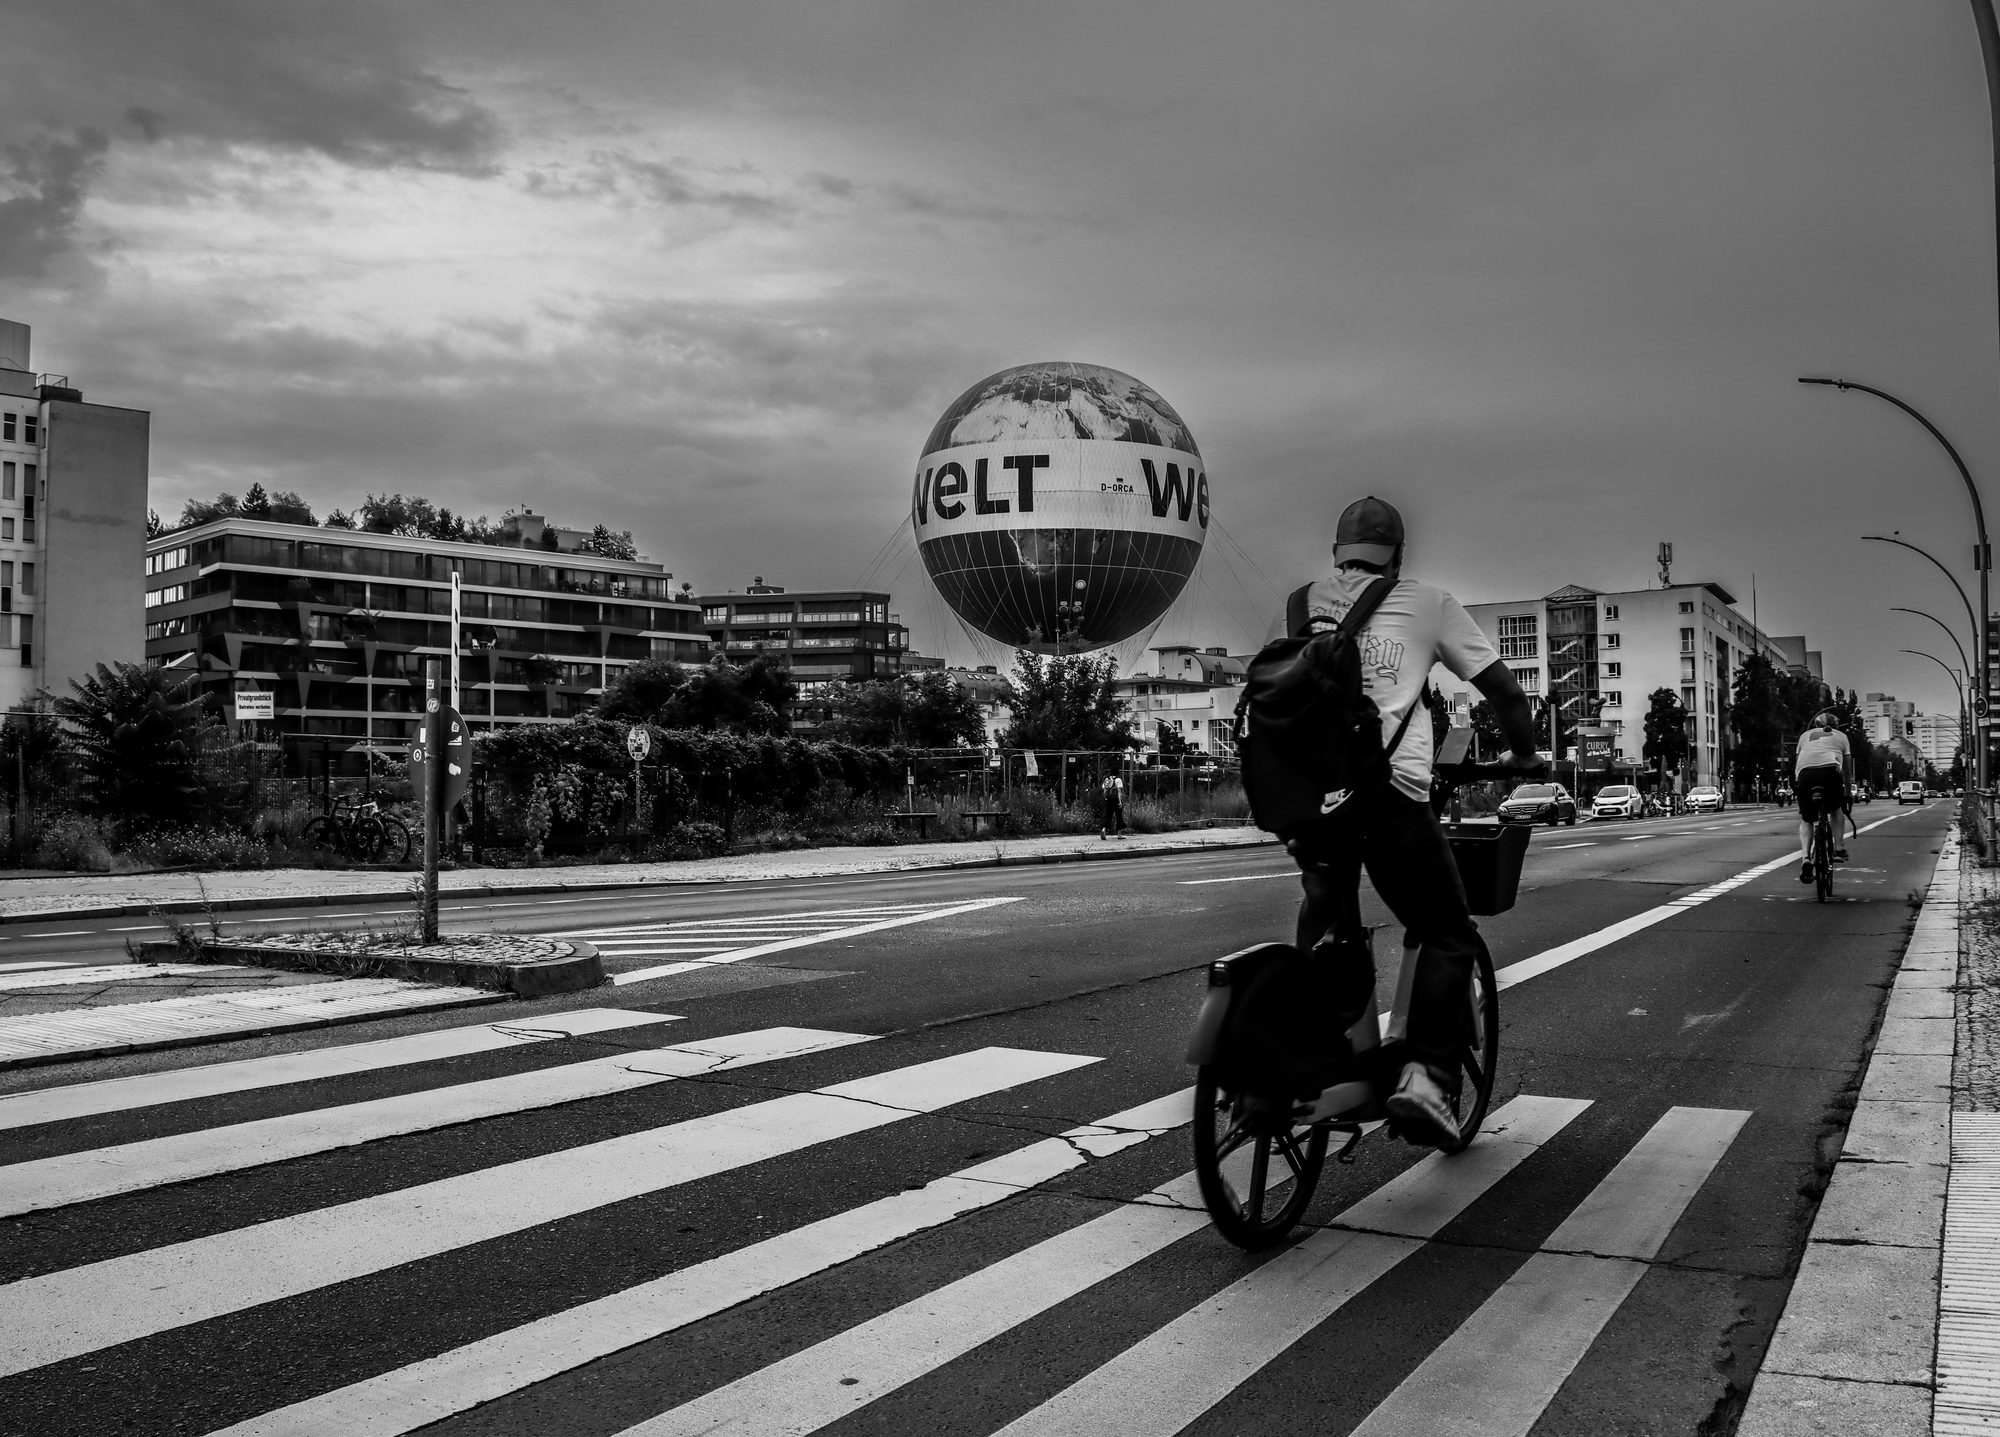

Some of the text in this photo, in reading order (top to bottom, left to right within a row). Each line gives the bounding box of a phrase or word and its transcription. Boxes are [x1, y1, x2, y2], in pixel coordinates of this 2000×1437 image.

[1101, 483, 1134, 493] D-ORCA
[237, 694, 271, 702] Privatgrundstück
[1586, 741, 1609, 750] CURRY
[1324, 788, 1346, 804] NIKE
